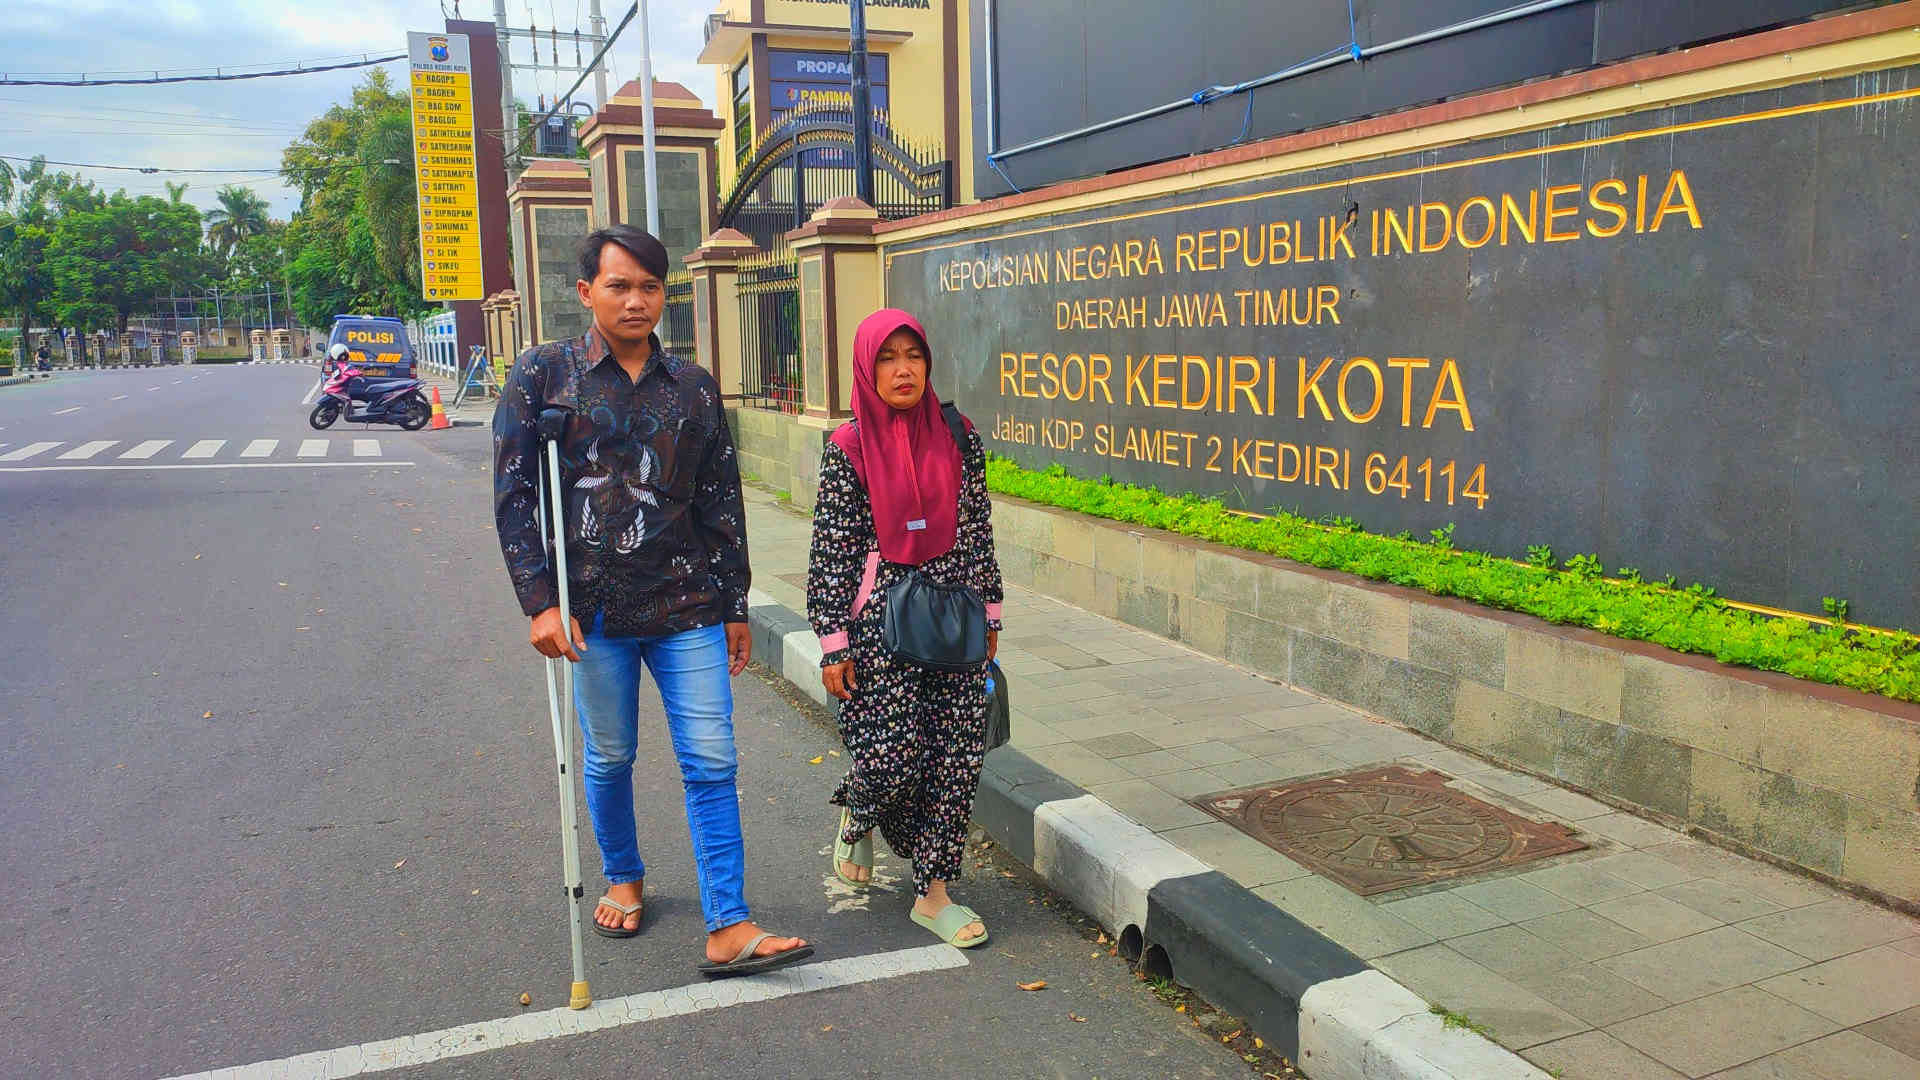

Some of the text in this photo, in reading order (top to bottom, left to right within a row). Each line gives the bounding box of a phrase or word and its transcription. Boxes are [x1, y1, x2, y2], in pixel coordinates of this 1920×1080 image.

[796, 60, 852, 74] PROPA
[426, 74, 456, 84] BAGOPS
[801, 89, 853, 102] PAMINA
[428, 102, 442, 111] BAG
[428, 115, 457, 125] BAGLOG
[431, 169, 474, 178] SATSAMAPTA
[434, 196, 457, 205] SIWAS
[434, 209, 473, 218] SIPROPAM
[939, 169, 1703, 292] KEPOLISIAN NEGARA REPUBLIK INDONESIA
[436, 235, 461, 244] SIKUM
[439, 275, 459, 284] SIUM
[1056, 285, 1342, 330] DAERAH JAWA TIMUR
[347, 330, 395, 344] POLISI
[1000, 352, 1475, 432] RESOR KEDIRI KOTA
[991, 413, 1489, 510] Jalan KDP. SLAMET 2 KEDIRI 64114
